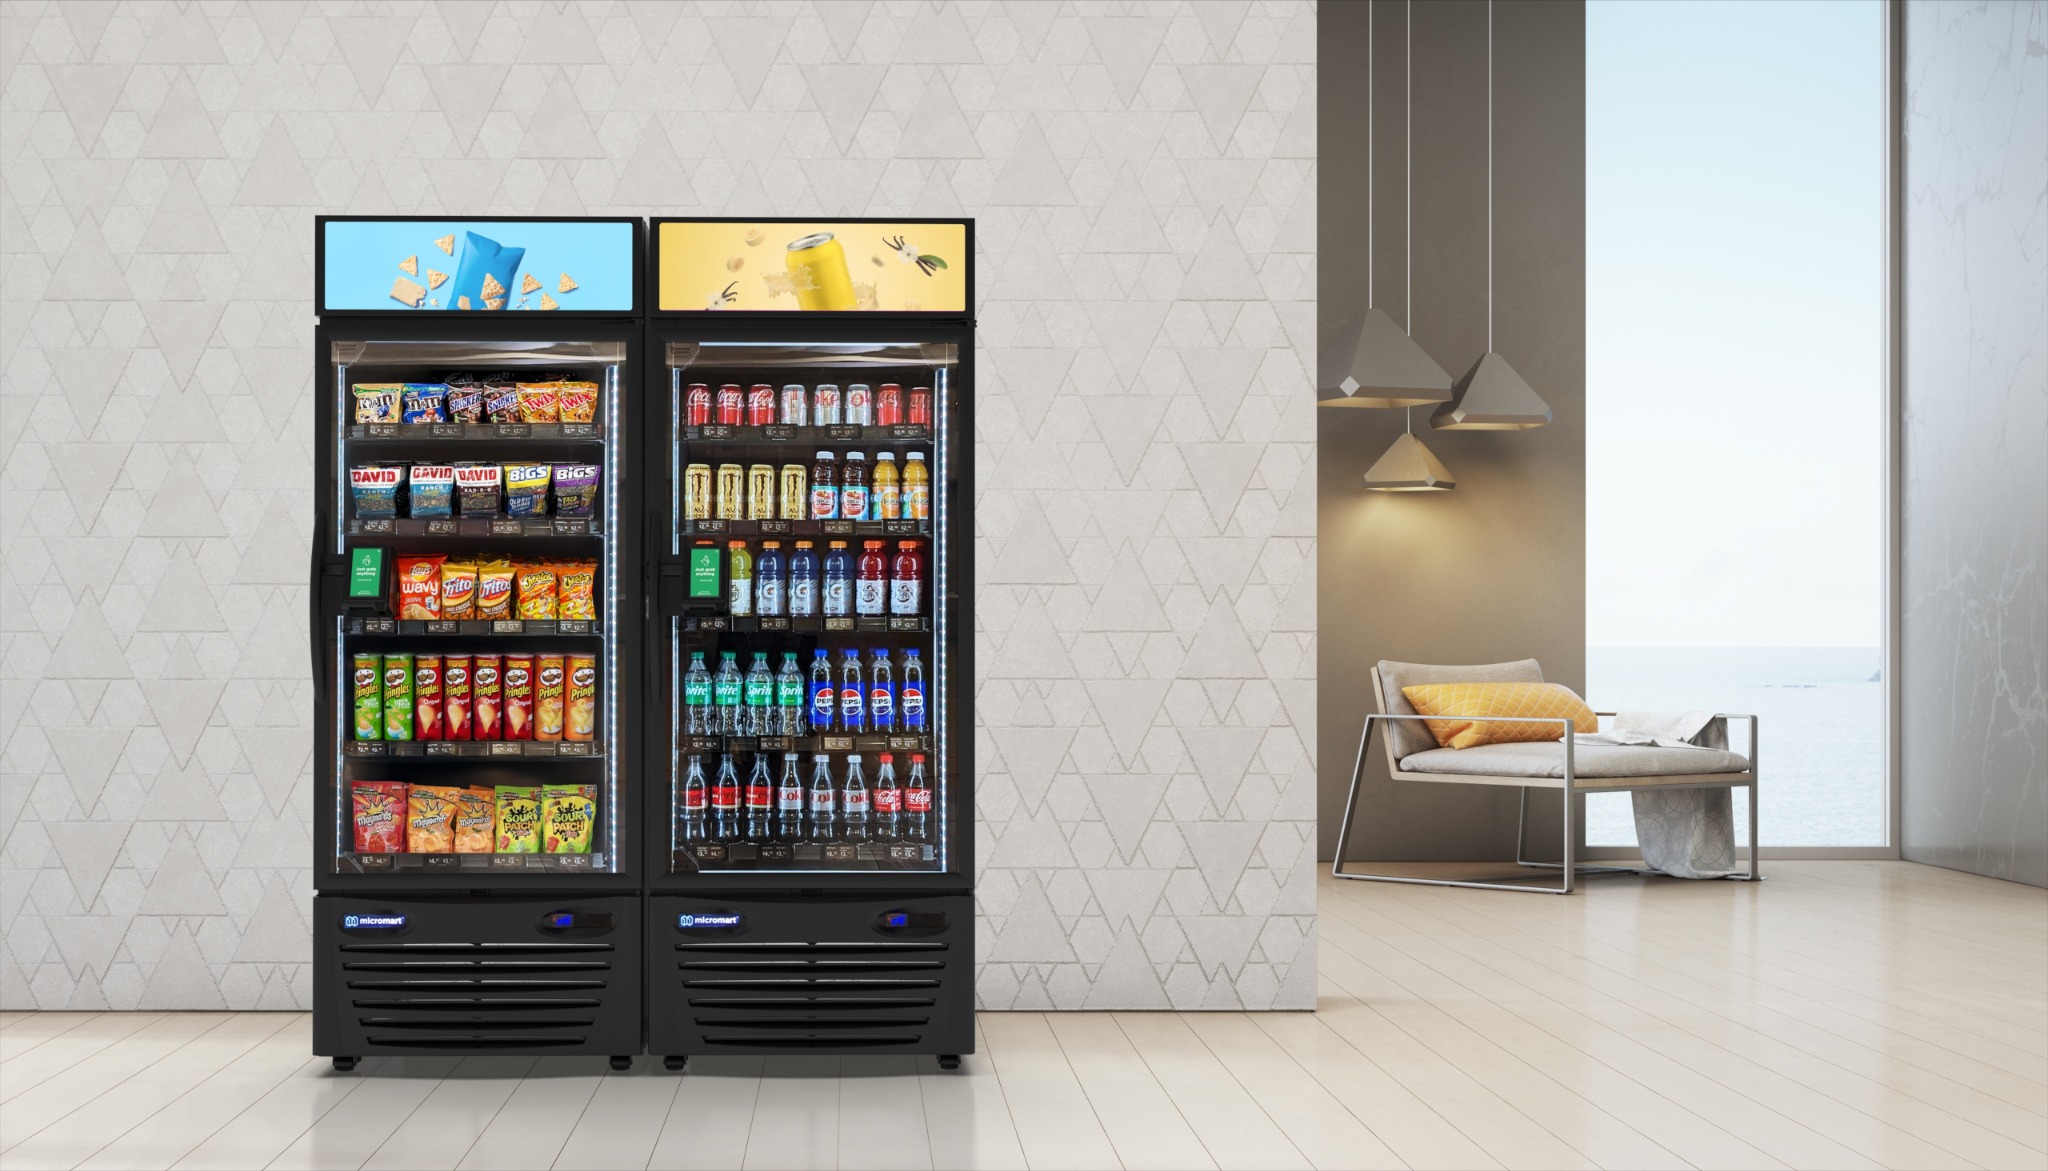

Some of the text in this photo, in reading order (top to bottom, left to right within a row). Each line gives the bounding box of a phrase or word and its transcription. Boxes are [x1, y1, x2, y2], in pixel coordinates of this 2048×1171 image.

[352, 471, 396, 482] DAVID
[412, 467, 453, 478] DAVID
[458, 469, 497, 481] DAVID
[402, 580, 438, 595] wavy
[443, 577, 473, 598] Frito
[539, 683, 563, 701] Pringle
[686, 685, 707, 696] prite
[716, 685, 738, 696] prite
[780, 685, 803, 697] Sprit
[505, 812, 534, 822] SOUR
[554, 811, 584, 822] SOUR
[504, 821, 534, 831] PATCH
[553, 820, 584, 831] PATCH
[360, 917, 403, 925] micromart
[694, 916, 738, 924] micromart
